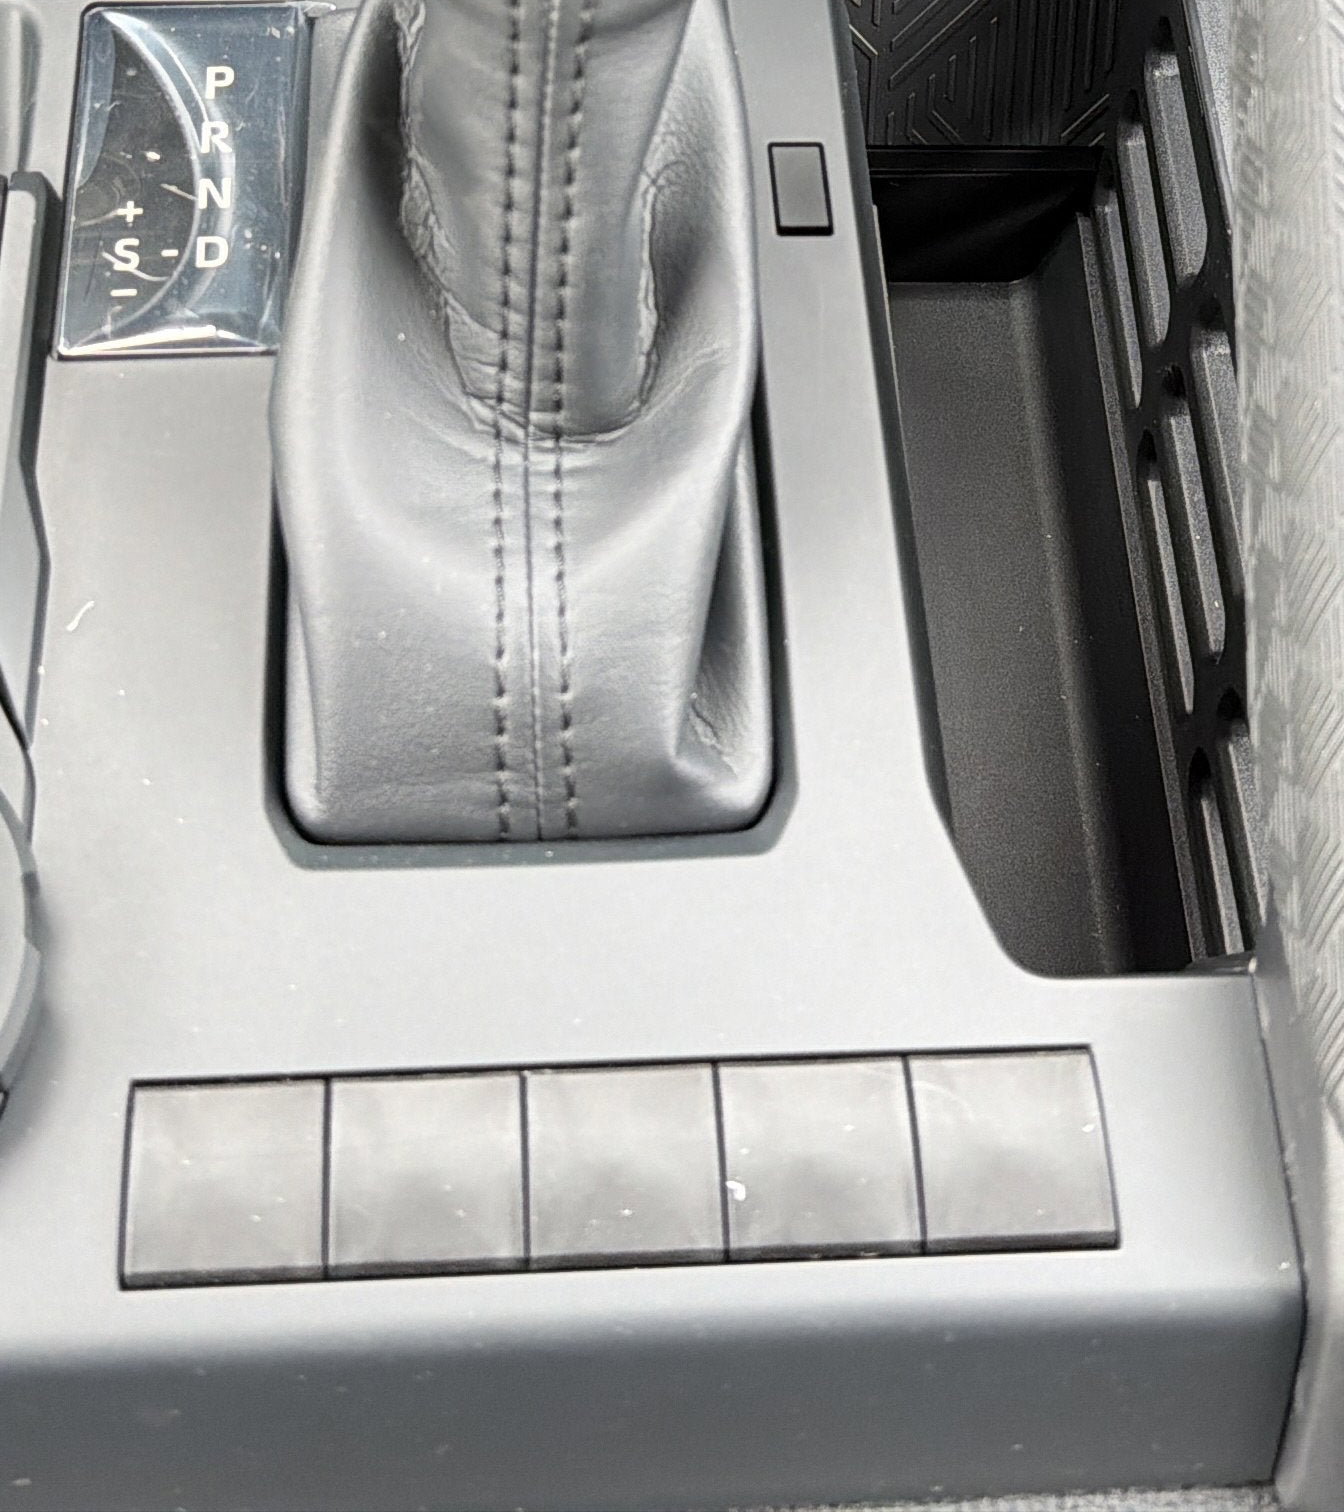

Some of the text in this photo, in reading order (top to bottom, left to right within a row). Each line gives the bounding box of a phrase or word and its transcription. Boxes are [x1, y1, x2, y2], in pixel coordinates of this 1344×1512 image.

[206, 65, 235, 99] P
[201, 120, 232, 153] R
[198, 177, 232, 209] N
[114, 237, 140, 271] S
[195, 236, 229, 268] D
